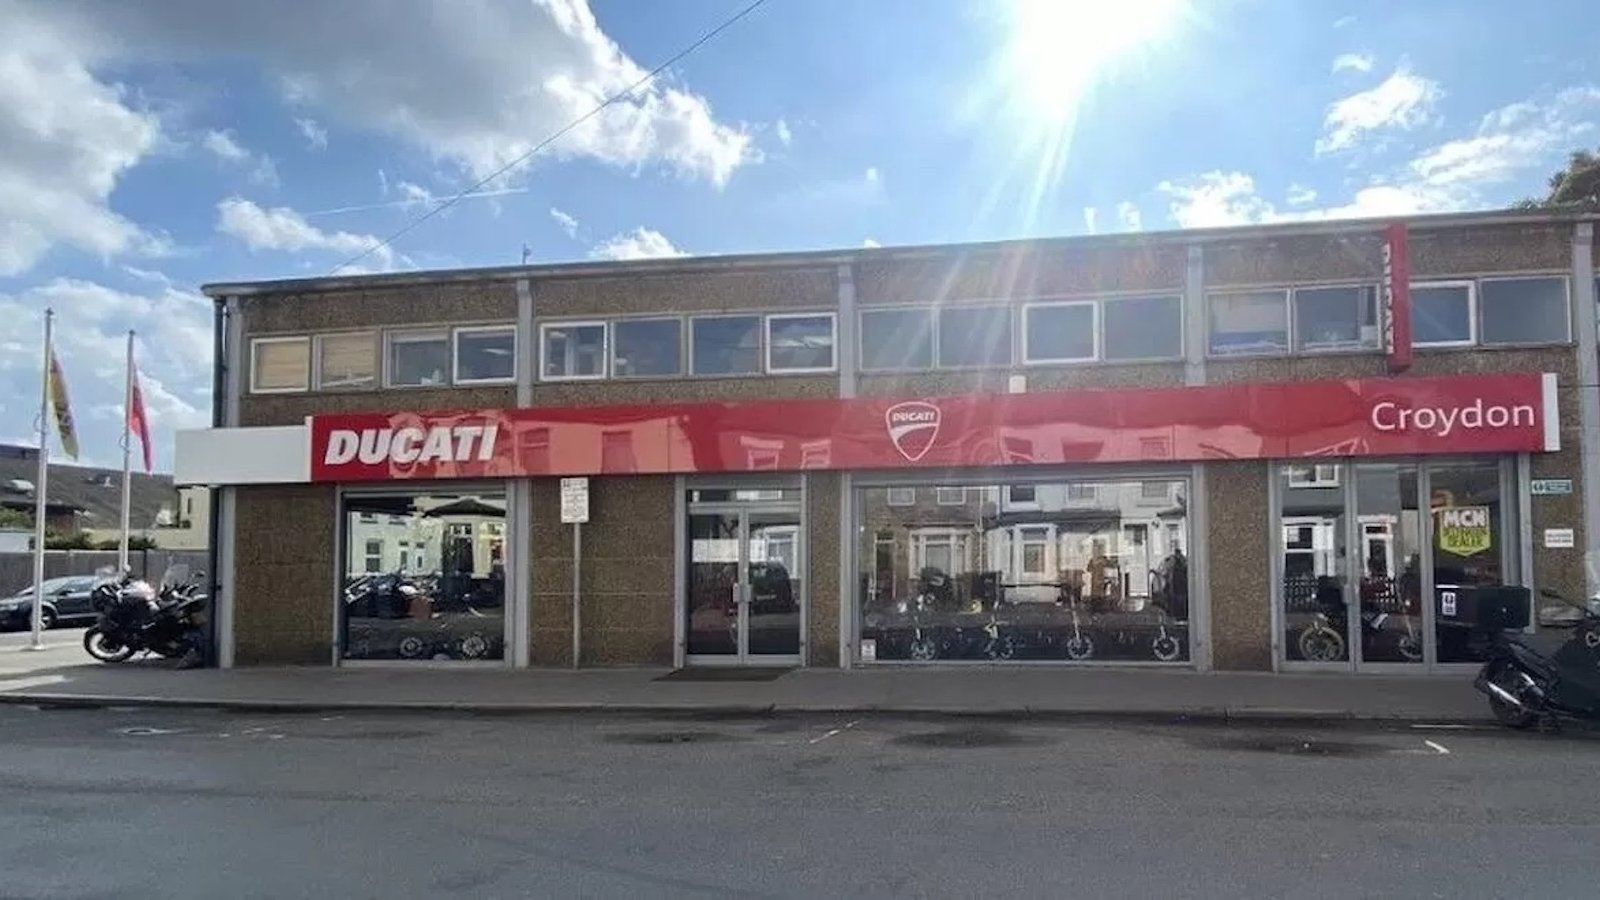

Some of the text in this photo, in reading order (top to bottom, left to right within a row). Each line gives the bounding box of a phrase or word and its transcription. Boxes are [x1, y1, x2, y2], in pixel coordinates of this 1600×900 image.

[893, 411, 935, 422] DUCATI
[1371, 398, 1535, 436] Croydon
[324, 425, 498, 466] DUCATI
[1443, 509, 1486, 528] MCN
